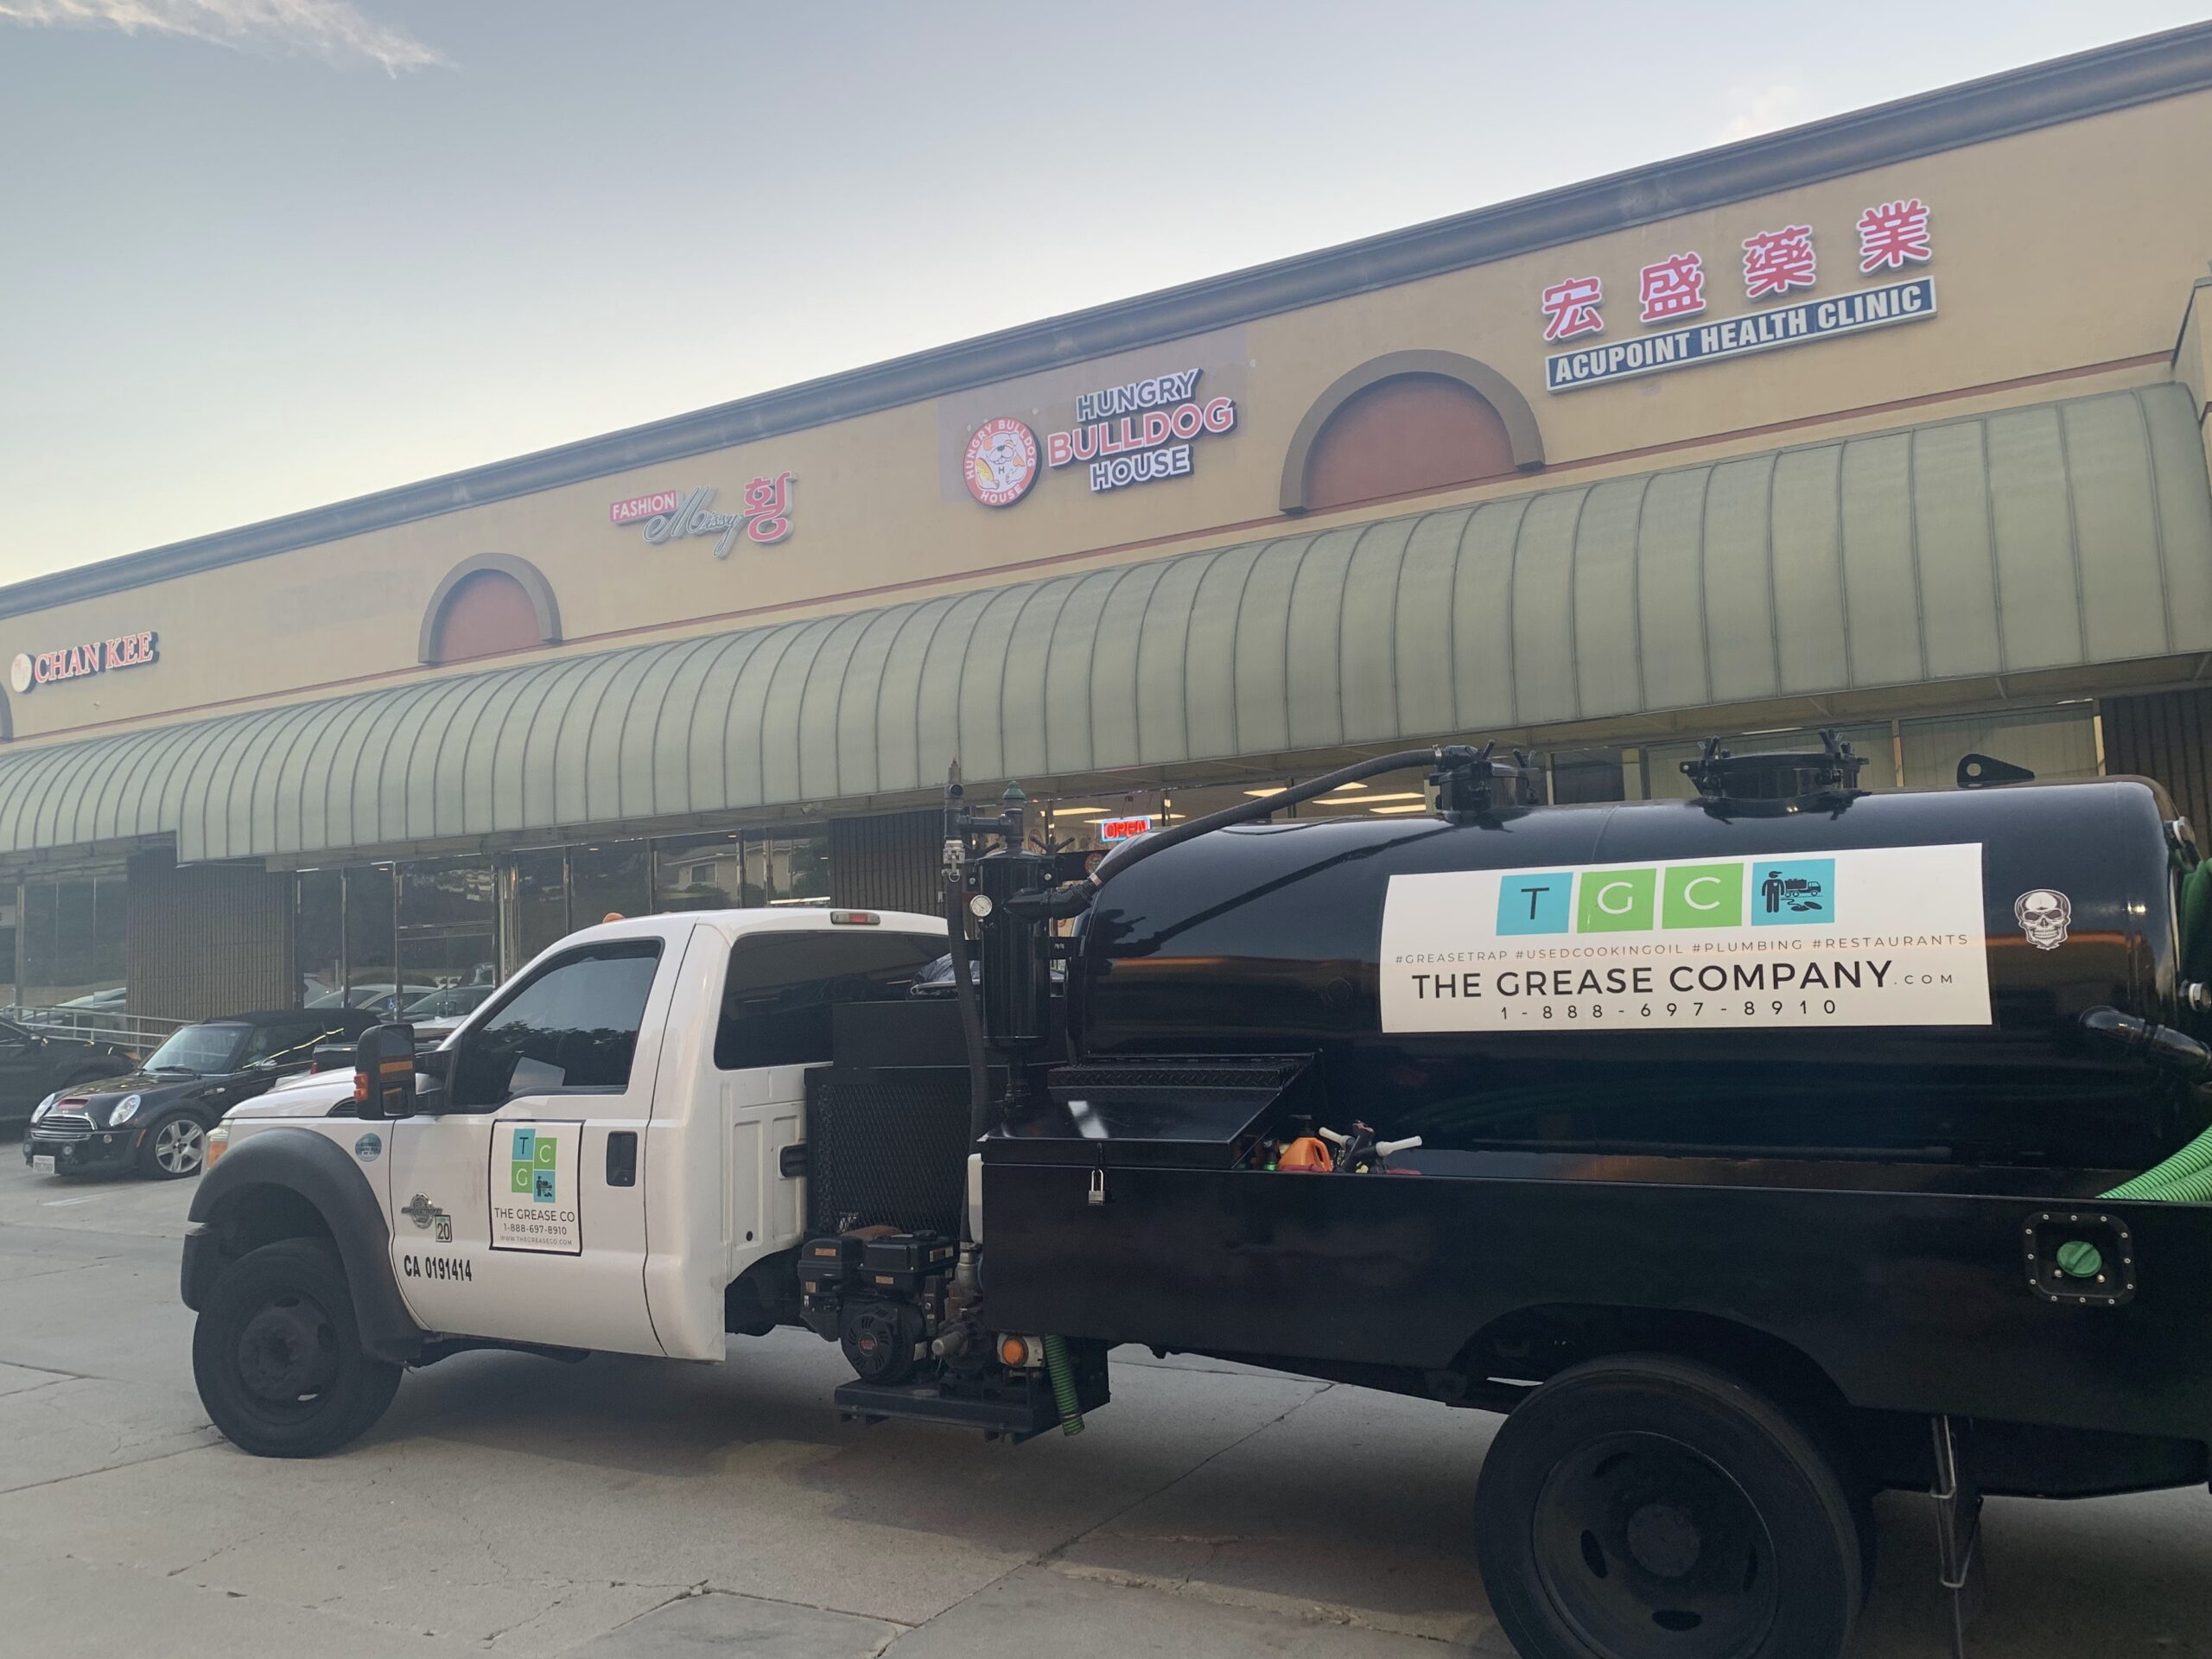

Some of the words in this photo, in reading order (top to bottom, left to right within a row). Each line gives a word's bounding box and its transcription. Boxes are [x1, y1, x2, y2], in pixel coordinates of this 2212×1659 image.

[1543, 199, 1931, 340] 宏盛藥業
[1555, 332, 1690, 383] ACUPOINT
[1700, 308, 1808, 353] HEALTH
[1817, 285, 1922, 329] CLINIC
[1077, 368, 1201, 423] HUNGRY
[1047, 397, 1235, 467] BULLDOG
[966, 423, 993, 480] HUNGRY
[998, 420, 1035, 467] BULLDOG
[1090, 444, 1191, 492] HOUSE
[613, 493, 675, 519] FASHION
[980, 483, 1023, 503] HOUSE
[34, 642, 100, 683] CHAN
[105, 631, 153, 669] KEE
[1105, 819, 1147, 838] OPEN
[1395, 950, 1509, 964] #GREASETRAP
[1516, 944, 1683, 960] #USEDCOOKINGOIL
[1692, 939, 1802, 952] #PLUMBING
[1812, 934, 1968, 949] #RESTAURANTS
[1412, 973, 1482, 999] THE
[1496, 967, 1653, 996] GREASE
[494, 1208, 513, 1219] THE
[517, 1209, 557, 1222] GREASE
[560, 1211, 575, 1223] CO
[504, 1224, 567, 1236] 1-888-697-8910
[437, 1223, 450, 1241] 20
[404, 1255, 422, 1278] CA
[425, 1257, 473, 1281] 0191414
